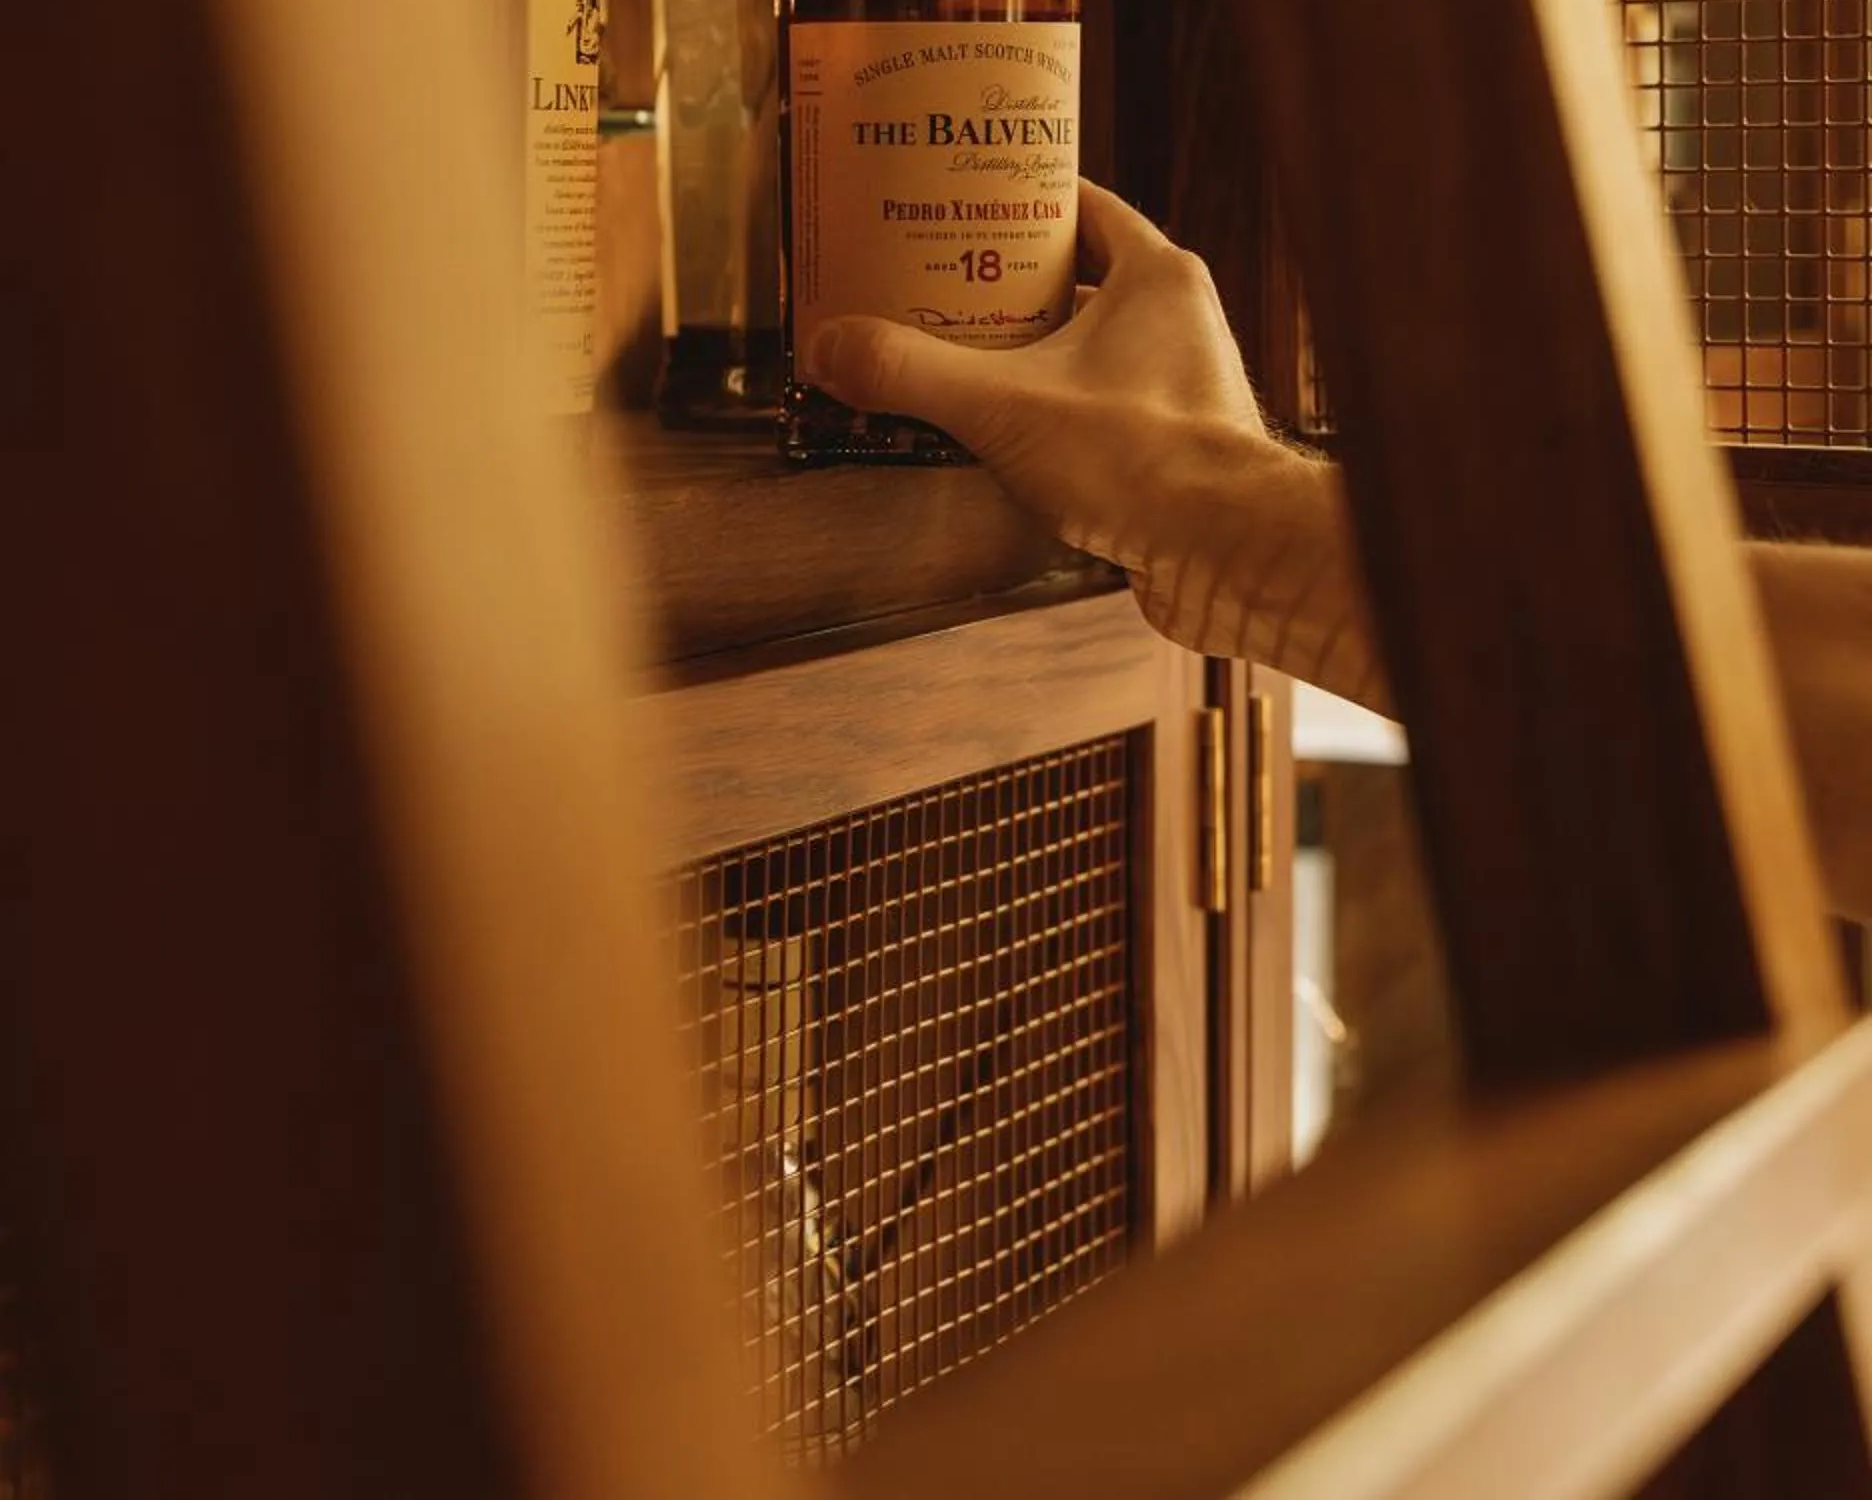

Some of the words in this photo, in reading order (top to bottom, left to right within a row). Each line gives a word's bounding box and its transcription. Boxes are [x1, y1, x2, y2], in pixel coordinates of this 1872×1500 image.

[854, 51, 916, 87] SINGLE
[919, 44, 969, 64] MALT
[975, 43, 1034, 64] SCOTCH
[852, 122, 917, 145] THE
[927, 113, 1073, 146] BALVENIE
[883, 200, 946, 221] PEDRO
[960, 249, 1002, 283] 18
